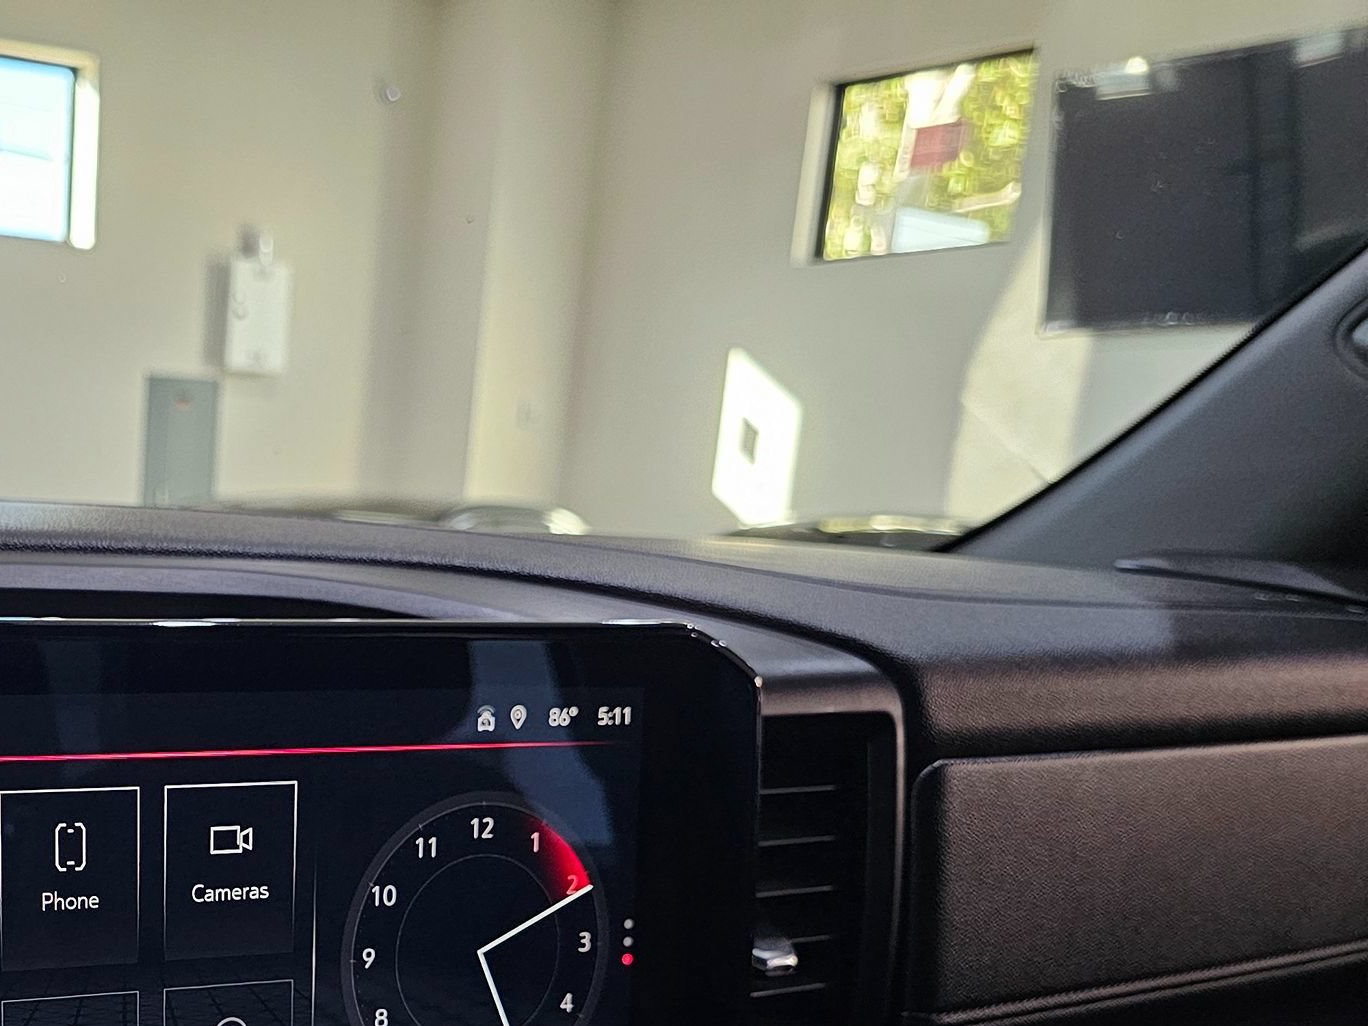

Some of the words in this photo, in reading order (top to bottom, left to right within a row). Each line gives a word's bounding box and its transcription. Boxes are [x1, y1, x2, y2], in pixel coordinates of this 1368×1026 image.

[598, 707, 631, 725] 5:11
[471, 817, 494, 838] 12
[416, 837, 436, 858] 11
[531, 832, 539, 852] 1
[192, 884, 269, 902] Cameras
[567, 875, 579, 895] 2
[42, 891, 99, 911] Phone
[372, 885, 397, 906] 10
[578, 932, 591, 952] 3
[363, 948, 375, 968] 9
[560, 993, 573, 1012] 4
